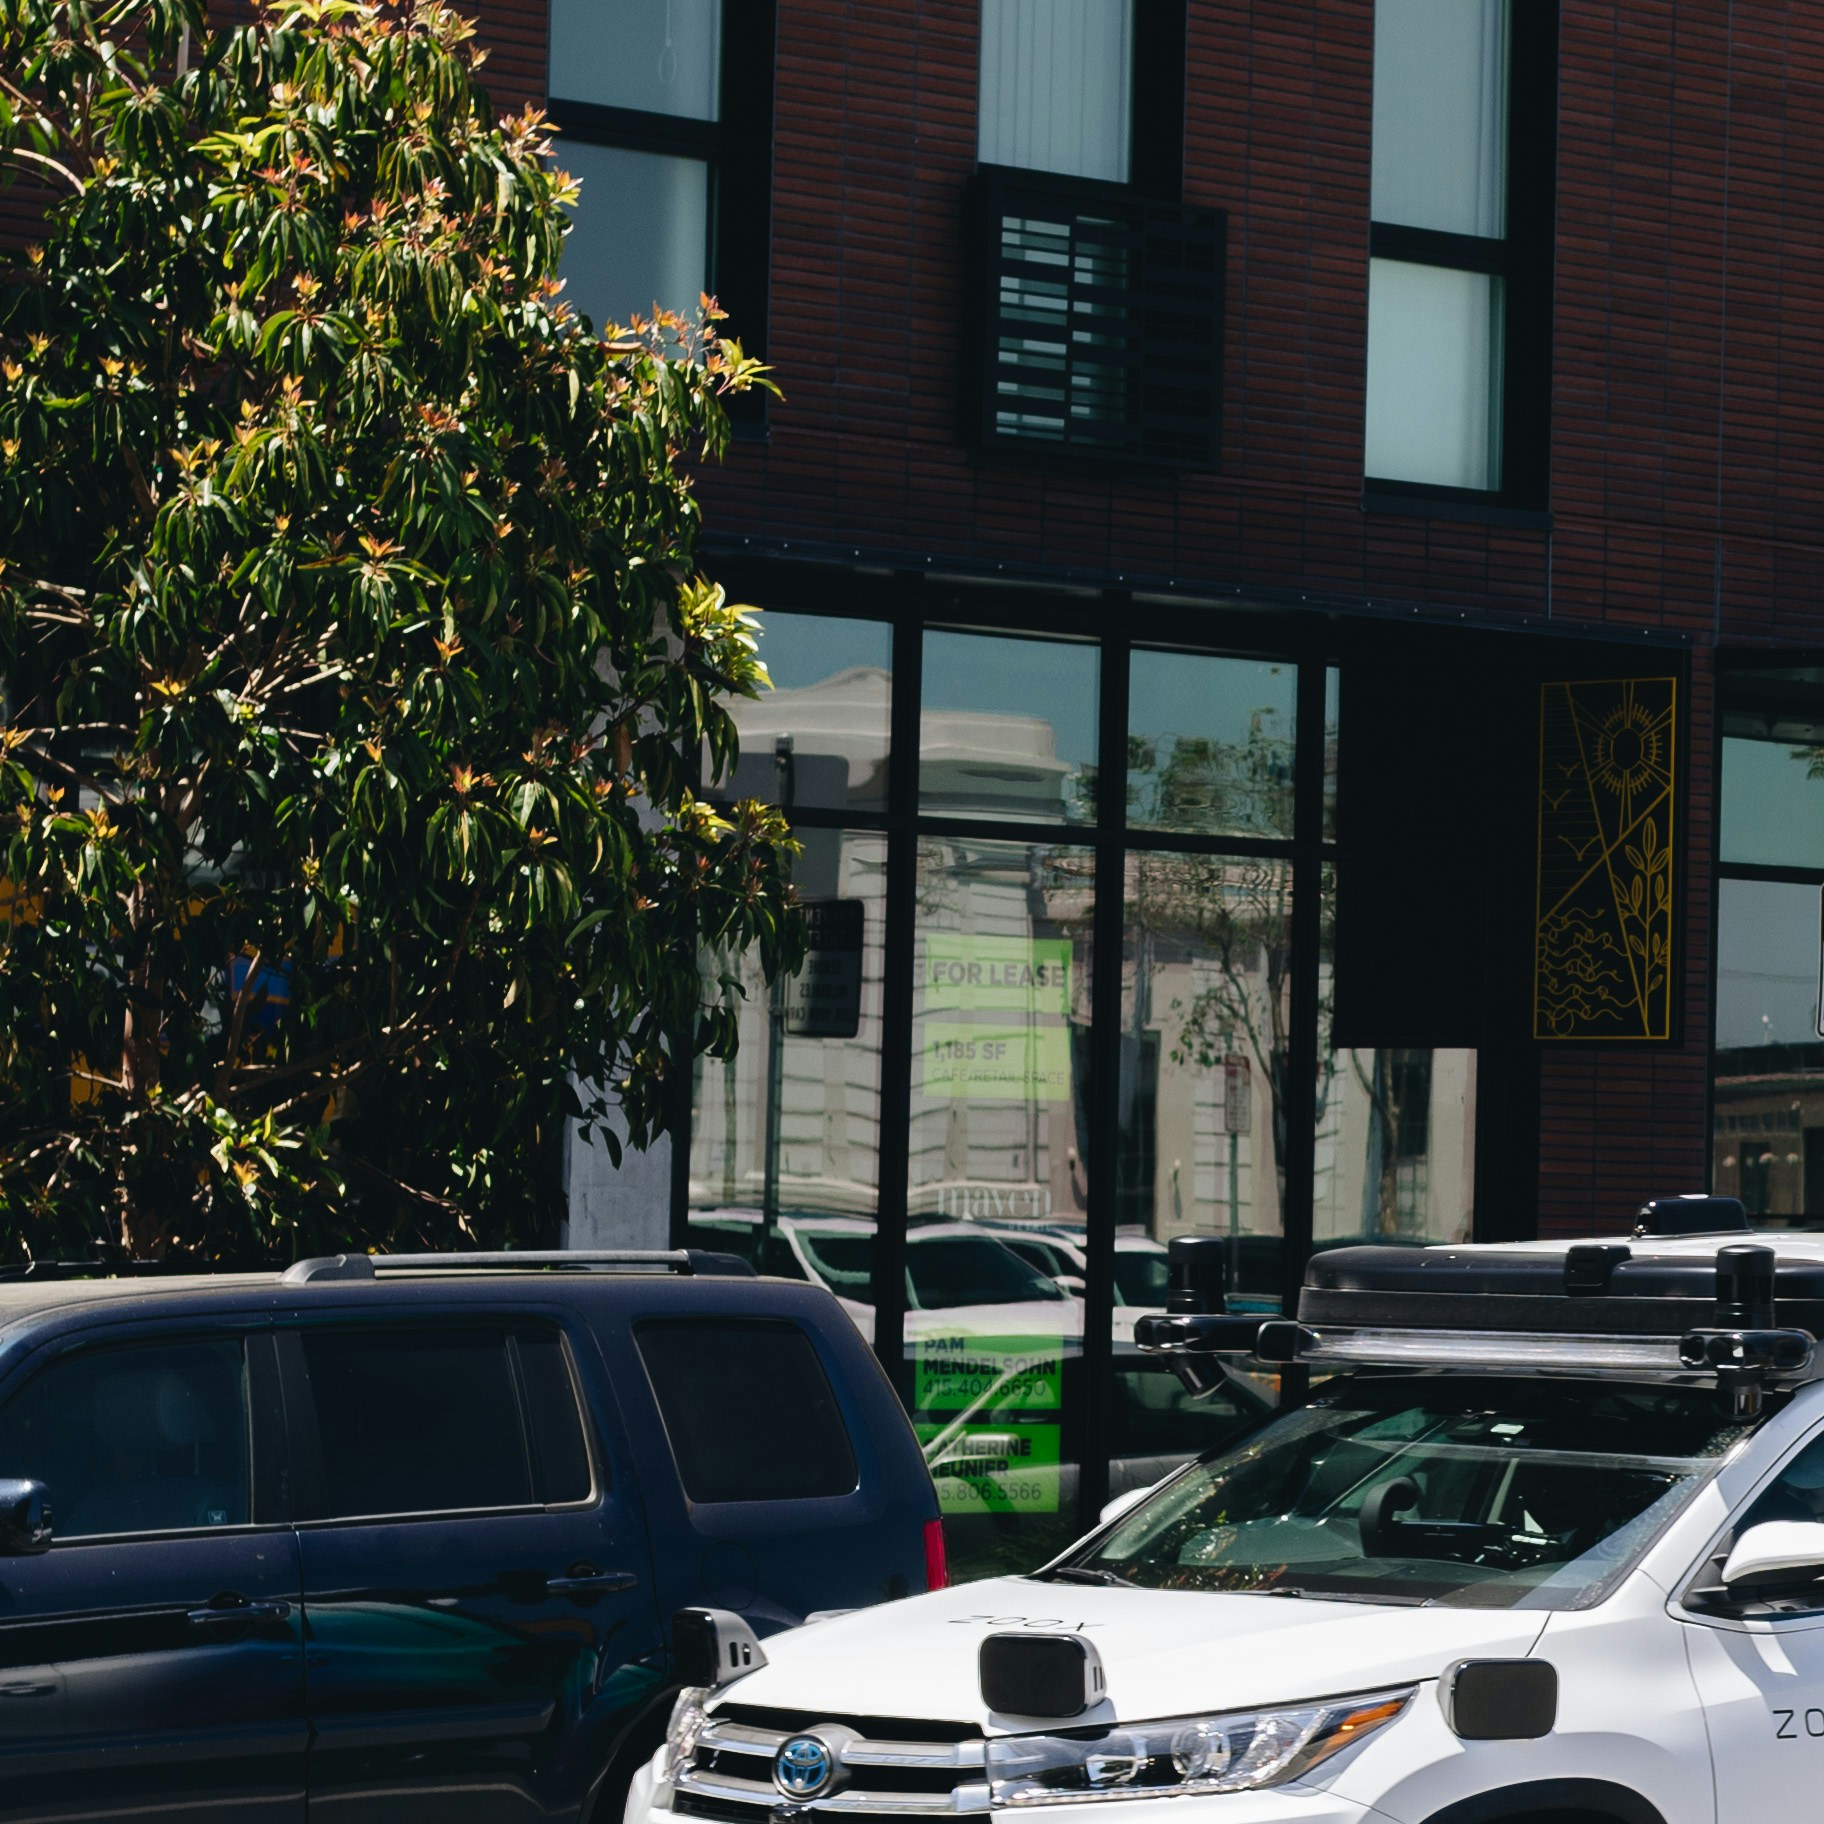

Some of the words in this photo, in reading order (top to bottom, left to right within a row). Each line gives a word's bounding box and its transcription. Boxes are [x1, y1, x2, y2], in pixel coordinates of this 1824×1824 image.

[933, 961, 982, 985] FOR
[990, 964, 1066, 988] LEASE
[933, 1040, 976, 1062] 1,185
[983, 1042, 1007, 1060] SF
[1023, 1070, 1066, 1085] SPACE
[938, 1187, 1051, 1222] maven
[924, 1337, 964, 1353] PAM
[924, 1358, 1056, 1376] MENDELSOHN
[923, 1378, 1046, 1397] 415.404.6650
[947, 1615, 1104, 1631] ZOOX
